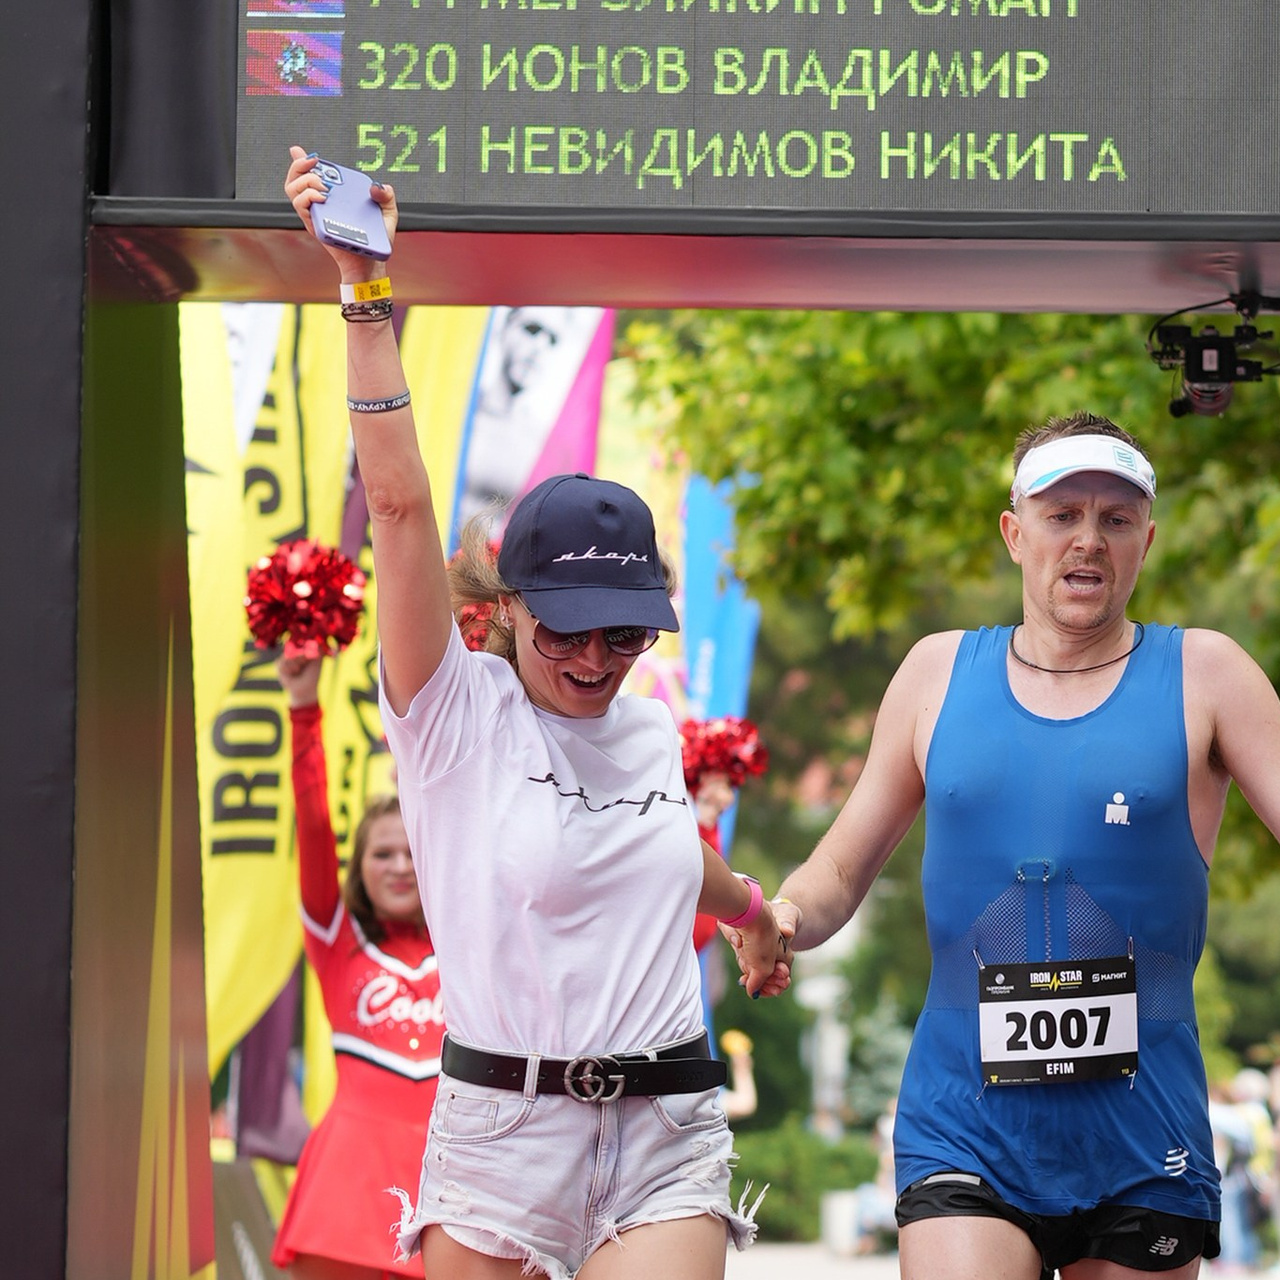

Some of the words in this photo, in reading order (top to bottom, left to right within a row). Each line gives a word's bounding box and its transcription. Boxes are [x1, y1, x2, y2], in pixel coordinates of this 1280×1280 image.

[359, 41, 457, 90] 320
[482, 44, 690, 94] ИОНОВ
[715, 47, 1050, 109] ВЛАДИМИР
[357, 123, 448, 173] 521
[480, 125, 854, 188] НЕВИДИМОВ
[882, 131, 1127, 182] НИКИТА
[1030, 971, 1050, 984] IRON
[1059, 970, 1083, 983] STAR
[1005, 1006, 1112, 1052] 2007
[1046, 1062, 1075, 1075] EFIM
